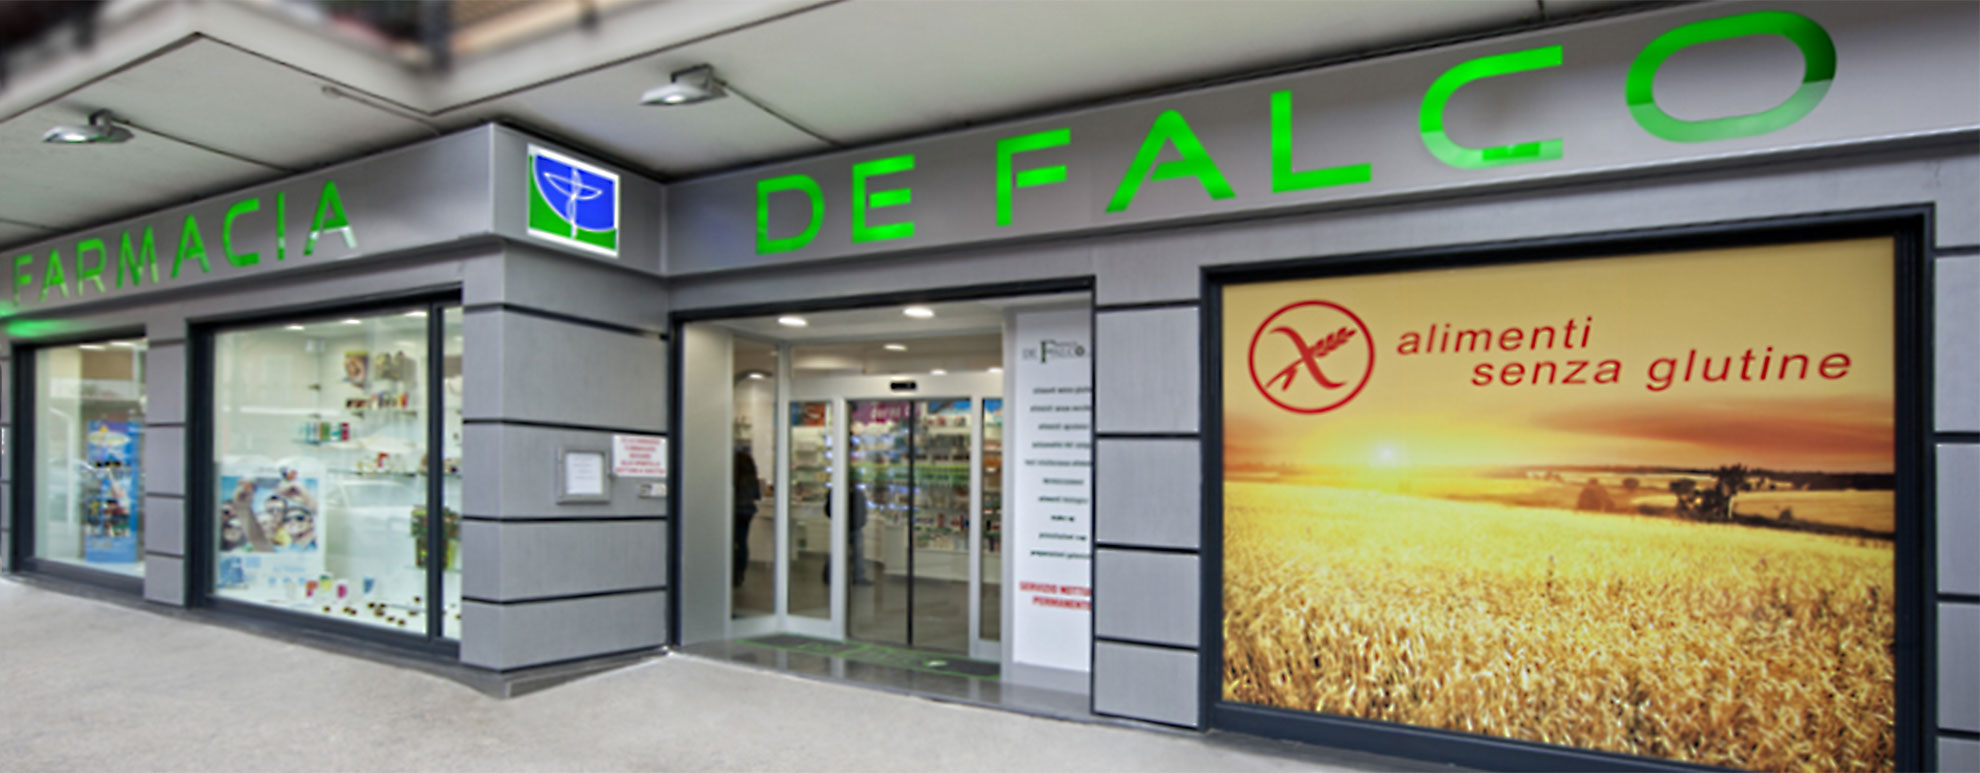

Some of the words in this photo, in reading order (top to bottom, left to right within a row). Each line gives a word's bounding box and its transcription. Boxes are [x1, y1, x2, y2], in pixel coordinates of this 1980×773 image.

[755, 153, 916, 255] DE
[994, 9, 1837, 226] FALCO
[12, 180, 358, 306] FARMACIA
[1396, 316, 1592, 354] alimenti
[1471, 358, 1622, 386] senza
[1645, 346, 1852, 392] glutine
